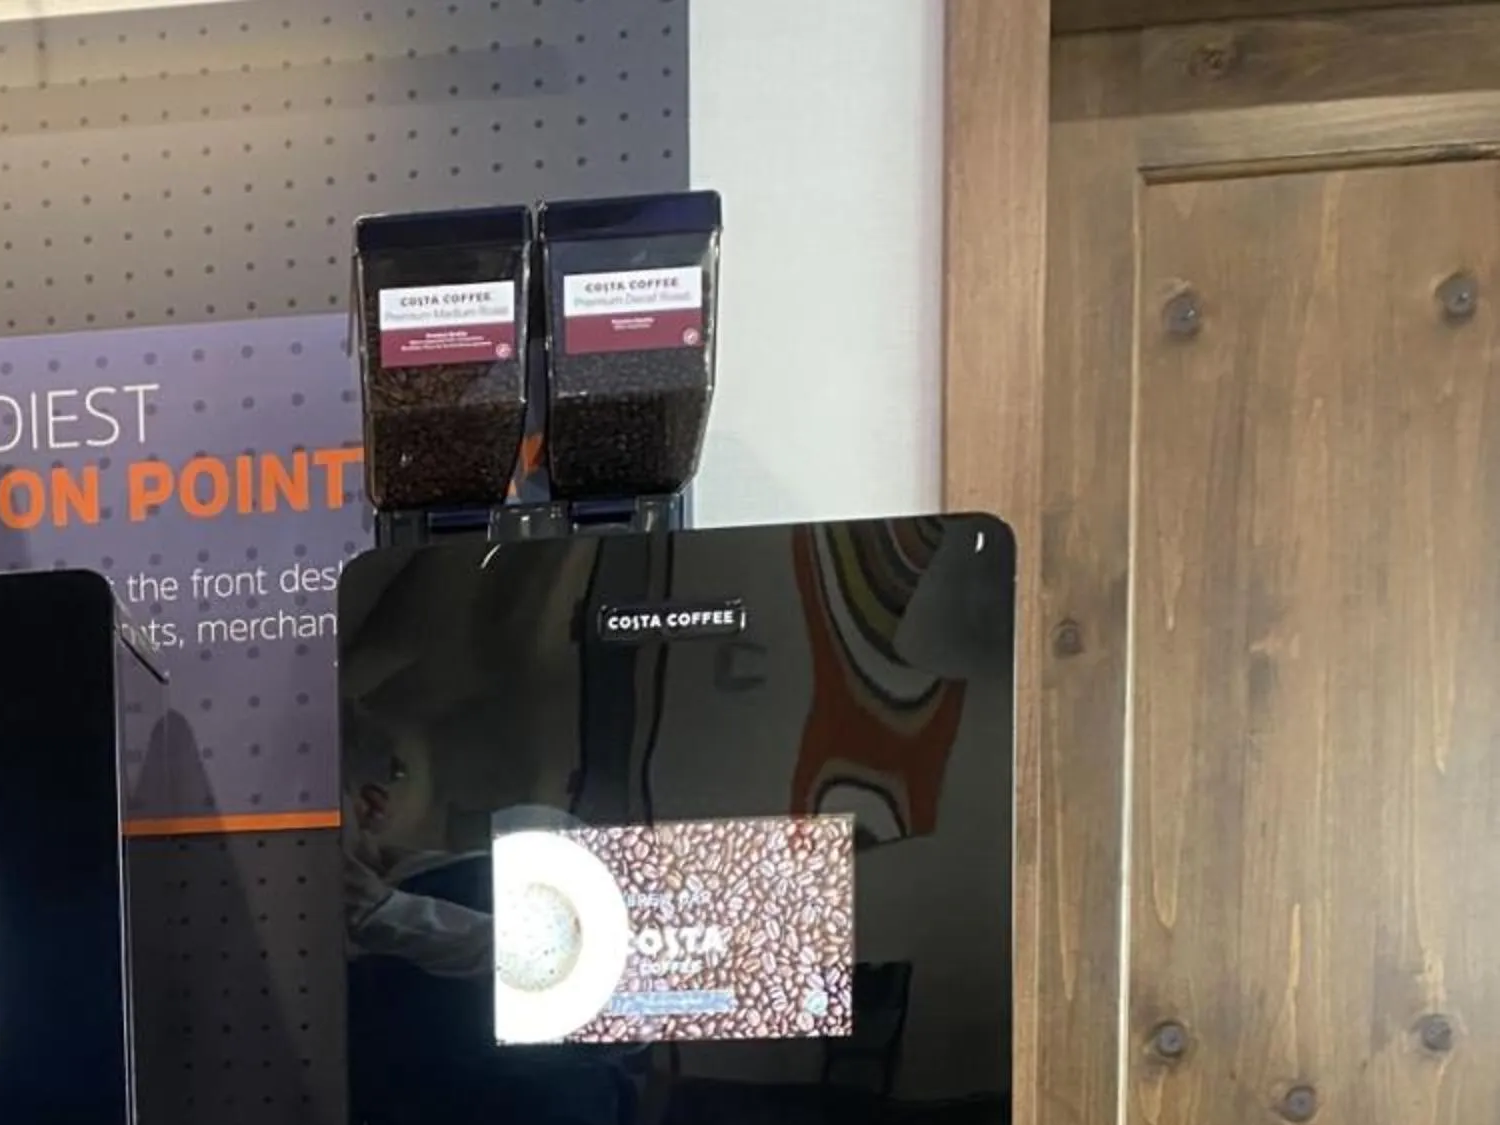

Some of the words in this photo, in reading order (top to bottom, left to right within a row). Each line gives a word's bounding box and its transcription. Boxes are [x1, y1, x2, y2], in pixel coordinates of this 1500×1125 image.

[128, 447, 365, 523] POINT
[127, 570, 178, 602] the
[190, 565, 268, 599] front
[608, 614, 662, 631] COSTA
[666, 610, 735, 628] COFFEE
